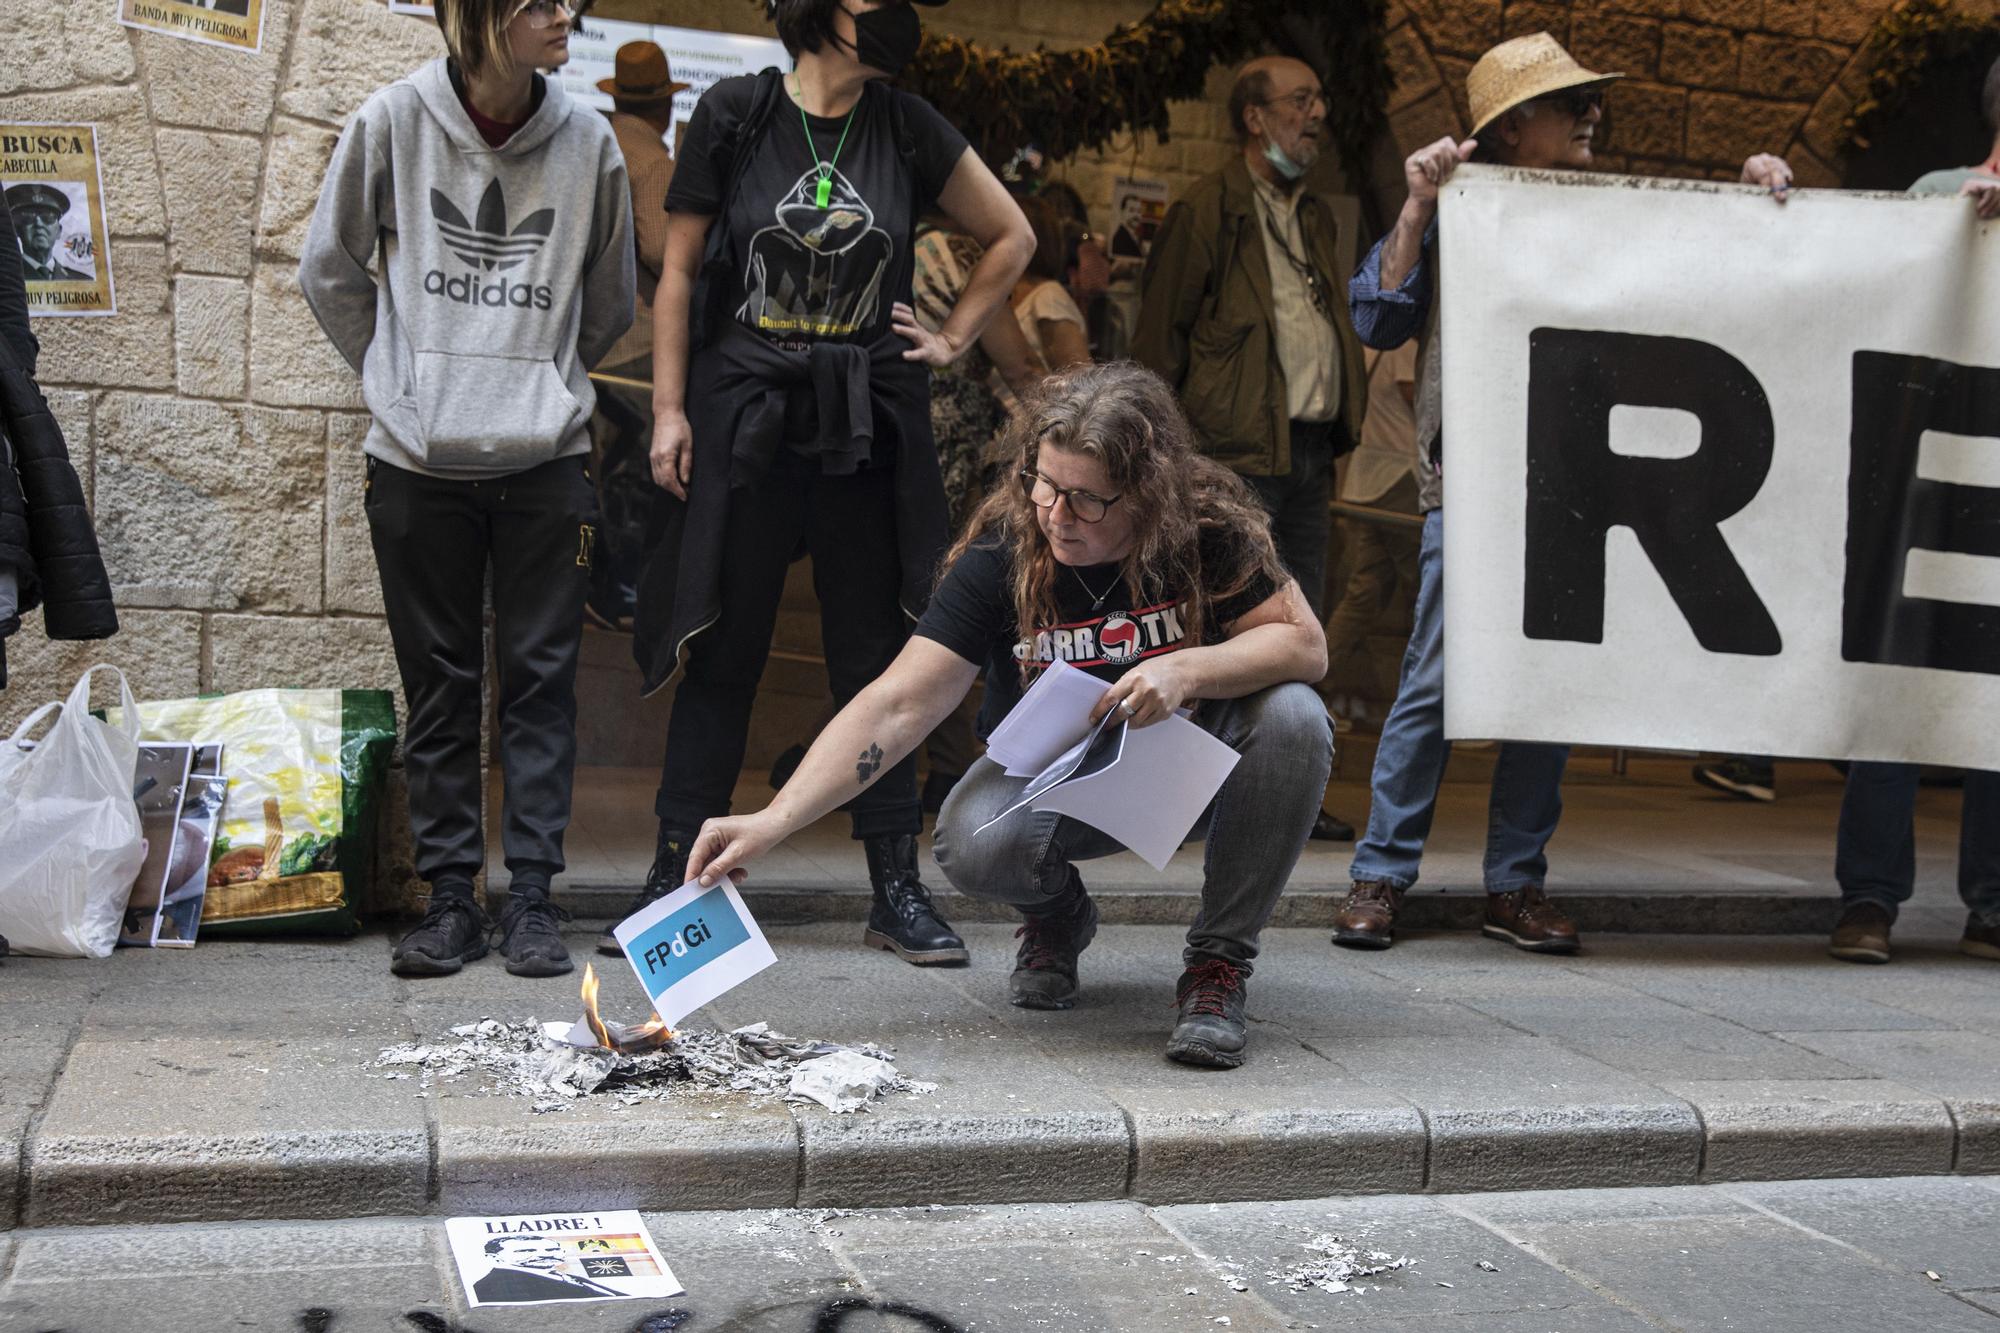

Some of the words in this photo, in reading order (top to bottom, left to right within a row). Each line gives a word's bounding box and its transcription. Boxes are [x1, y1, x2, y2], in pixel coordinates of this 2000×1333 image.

[134, 4, 168, 23] BANDA
[170, 10, 193, 28] MUY
[195, 17, 248, 41] PELIGROSA
[3, 136, 83, 154] BUSCA
[46, 291, 101, 305] PELIGROSA
[424, 270, 552, 311] adidas
[1523, 326, 2000, 675] RE
[1107, 612, 1127, 622] ACCIÓ
[644, 918, 712, 975] FPdGi
[485, 1218, 588, 1234] LLADRE
